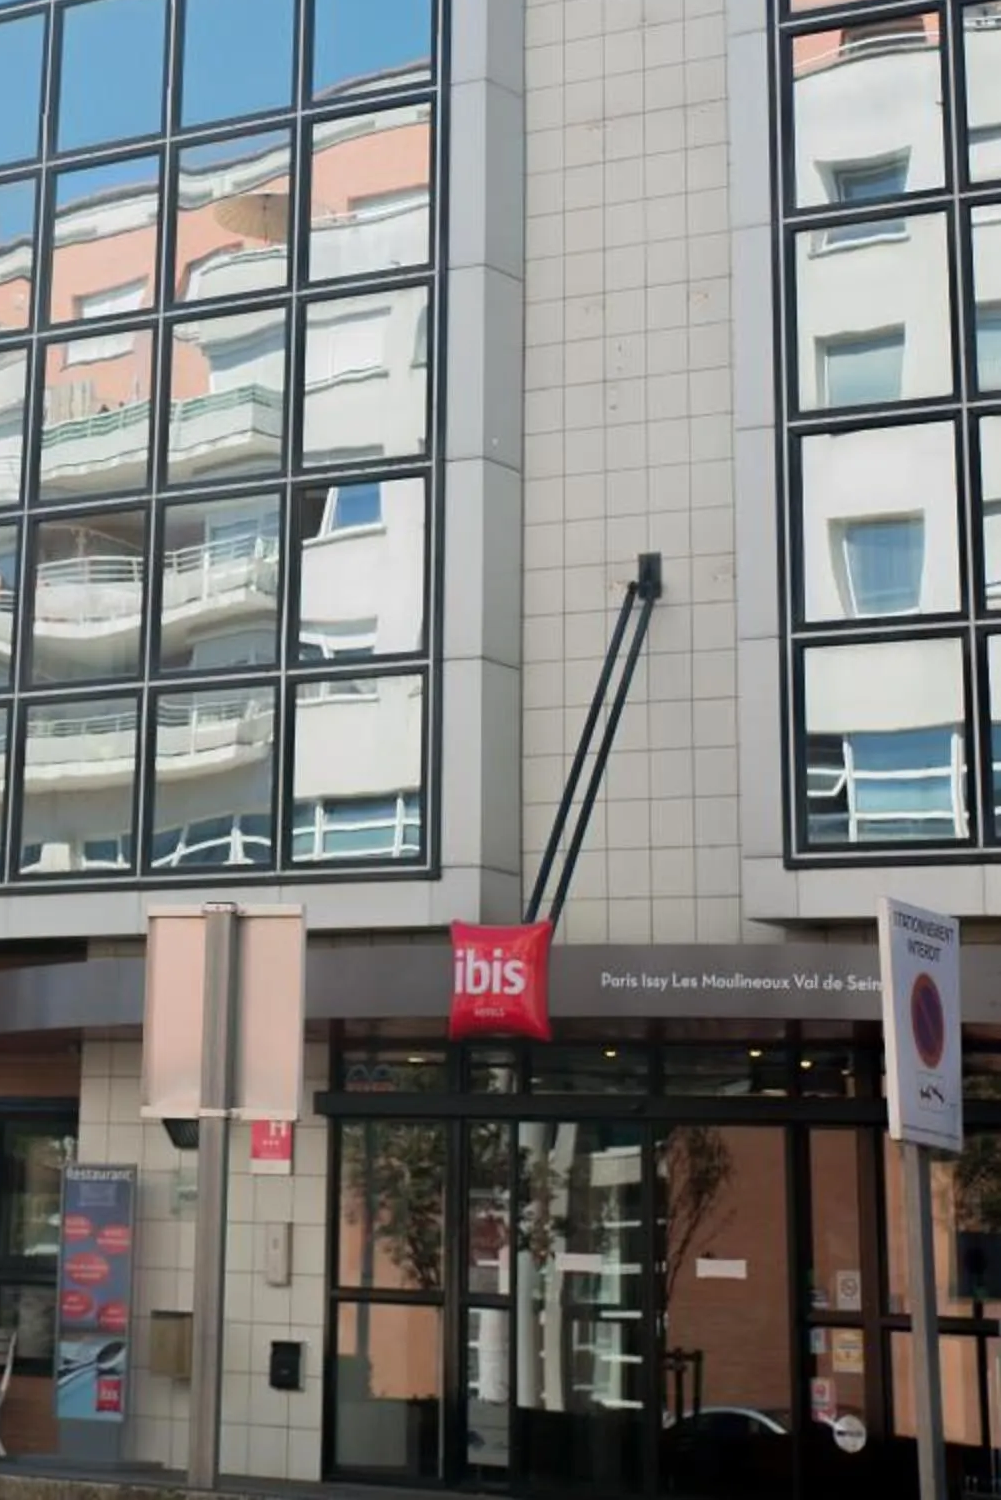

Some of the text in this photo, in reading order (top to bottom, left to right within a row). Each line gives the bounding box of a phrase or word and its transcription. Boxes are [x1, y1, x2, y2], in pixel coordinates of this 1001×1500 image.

[907, 938, 941, 963] INTERDIT
[455, 947, 527, 995] ibis
[601, 972, 883, 993] Paris Issy Les Moulineaux Val de Sein
